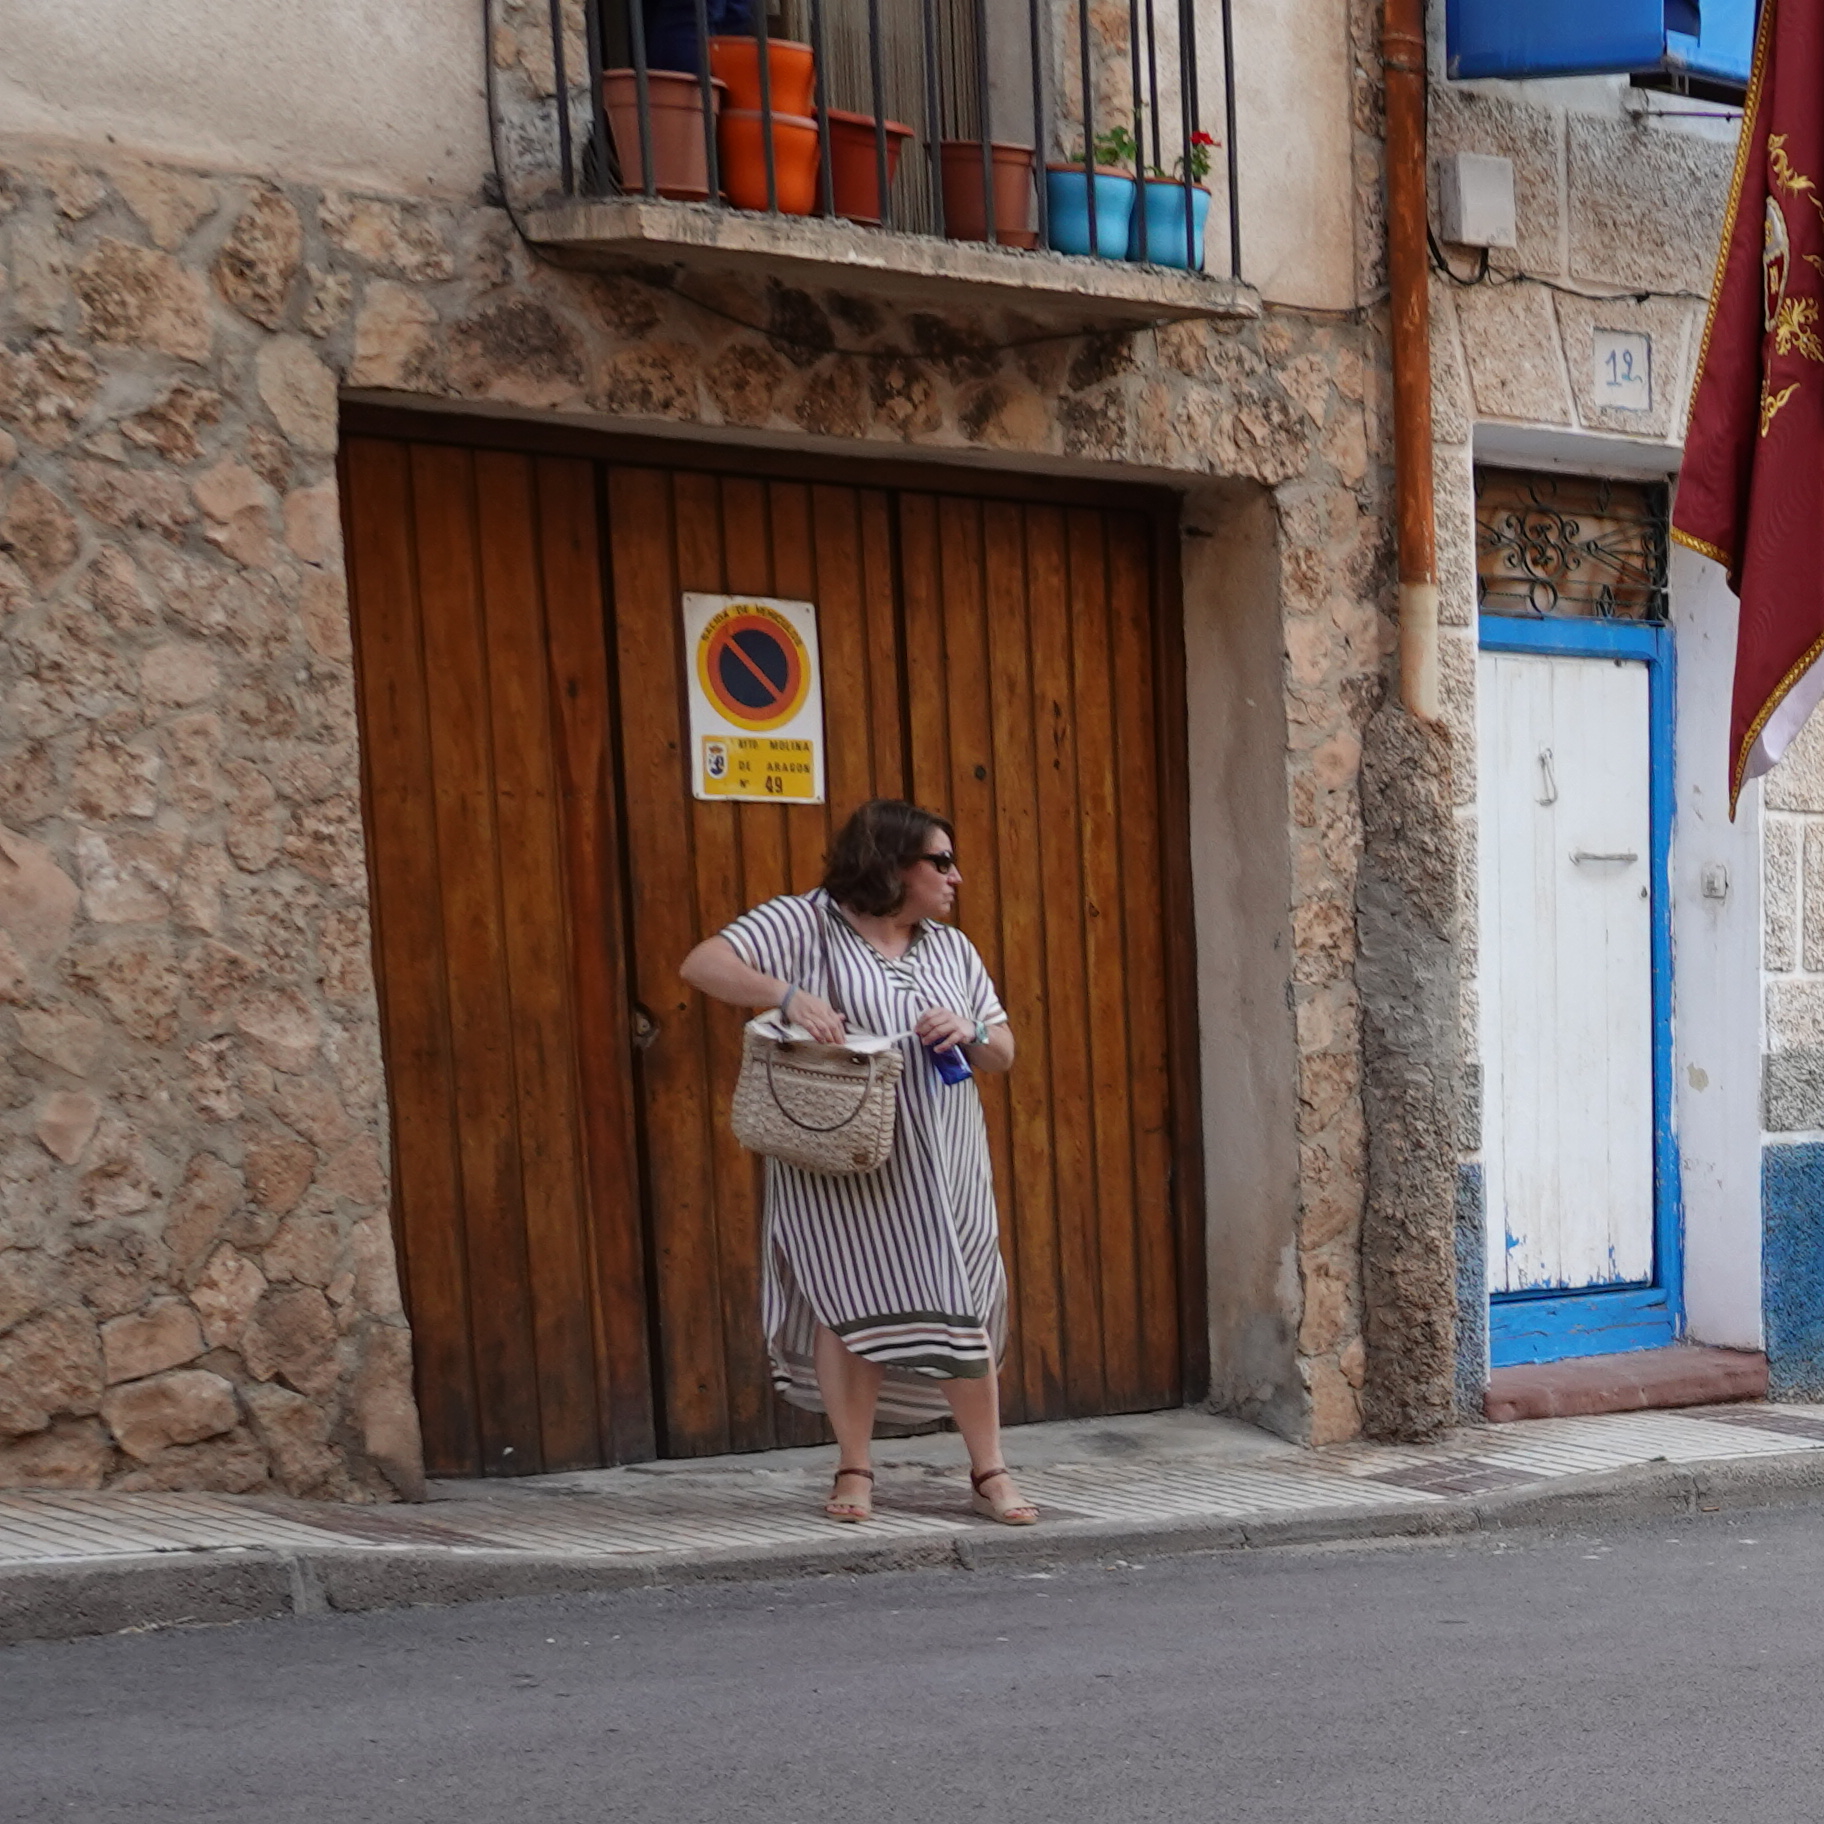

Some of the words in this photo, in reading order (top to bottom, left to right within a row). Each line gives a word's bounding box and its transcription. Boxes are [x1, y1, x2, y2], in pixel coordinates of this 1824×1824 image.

[1604, 348, 1643, 387] 12
[701, 608, 730, 641] SALIDA
[735, 604, 748, 614] DE
[769, 740, 810, 751] MOLINA
[738, 761, 751, 772] DE
[767, 762, 811, 773] ARAGON
[765, 775, 784, 793] 49
